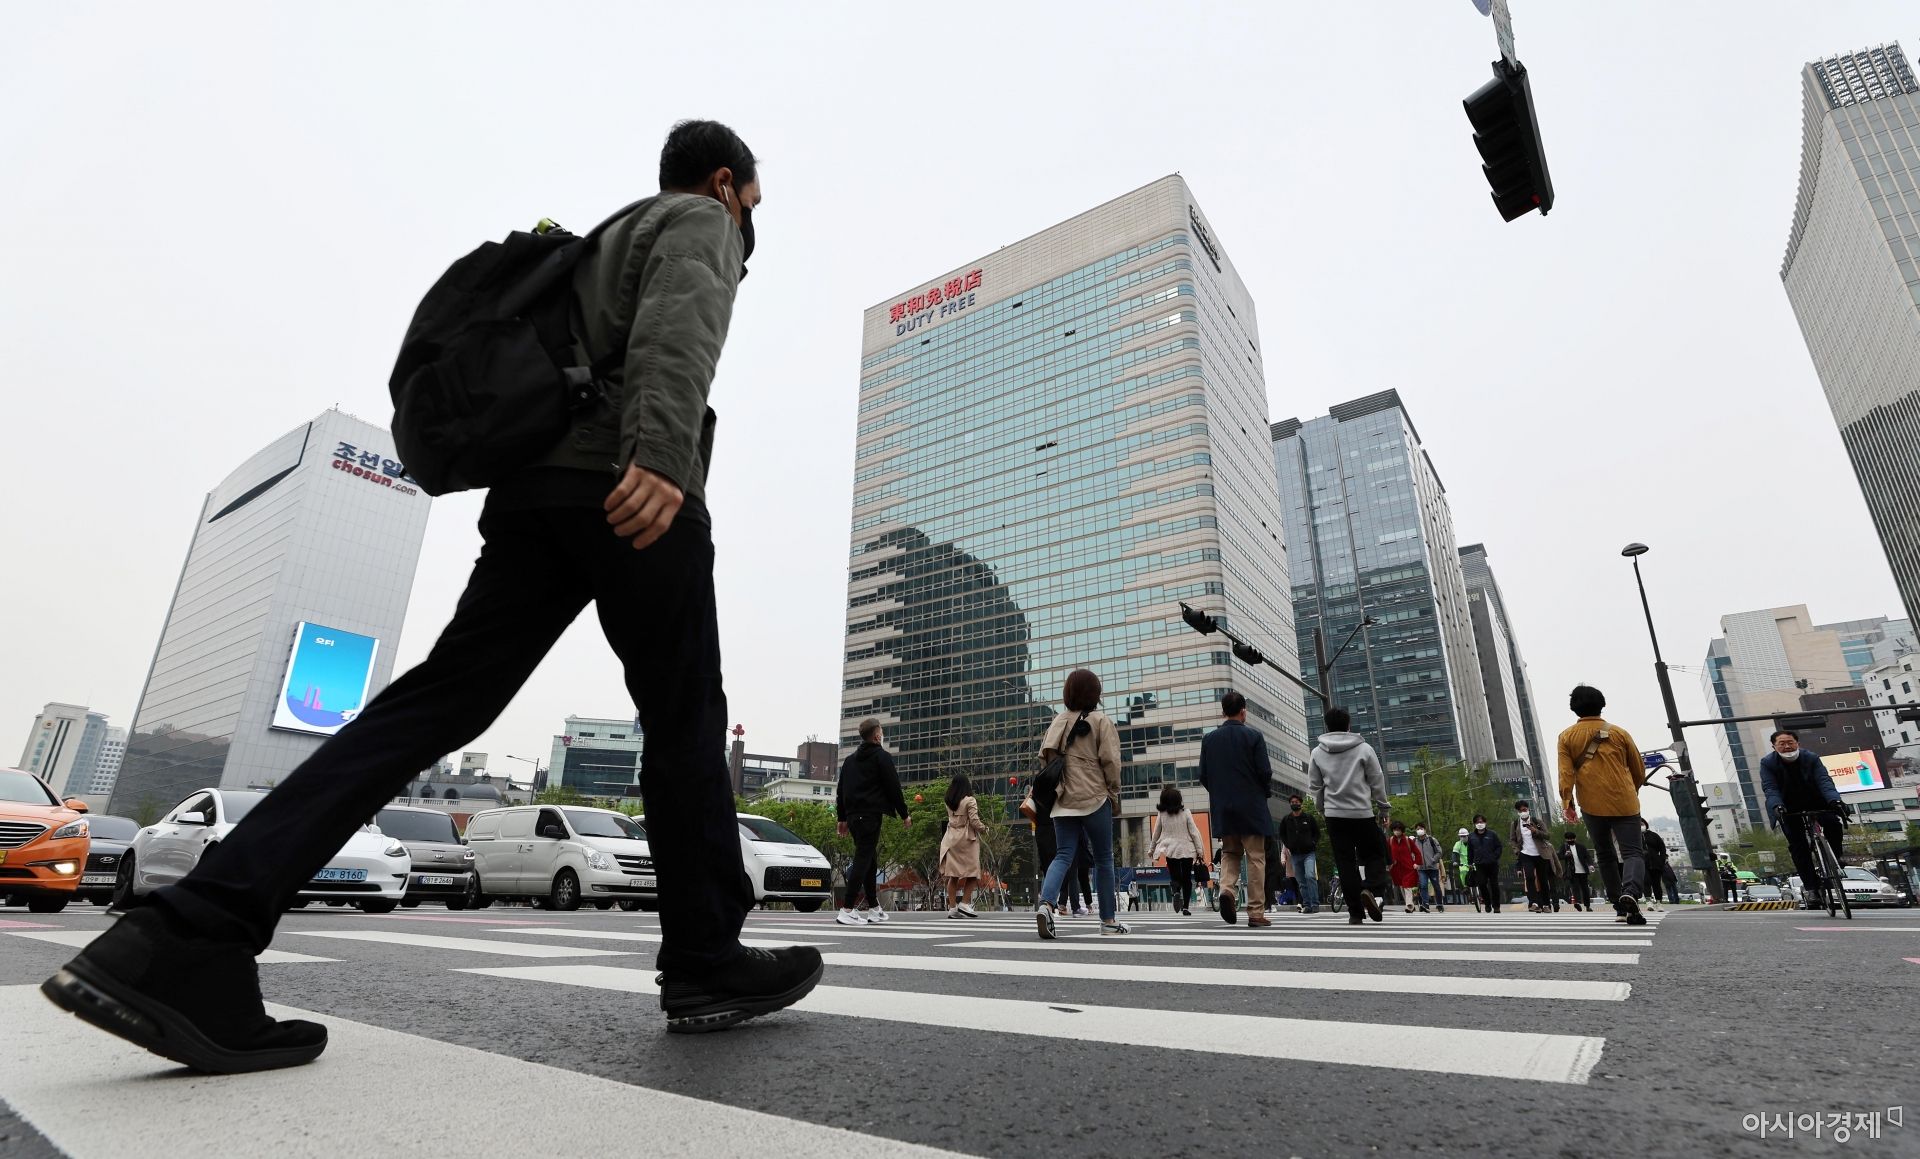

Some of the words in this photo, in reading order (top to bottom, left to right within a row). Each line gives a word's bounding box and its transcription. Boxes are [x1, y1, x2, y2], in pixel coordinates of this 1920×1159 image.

[896, 309, 934, 336] DUTY
[940, 293, 976, 318] FREE
[332, 459, 417, 496] chosun.com
[339, 870, 363, 879] 8160
